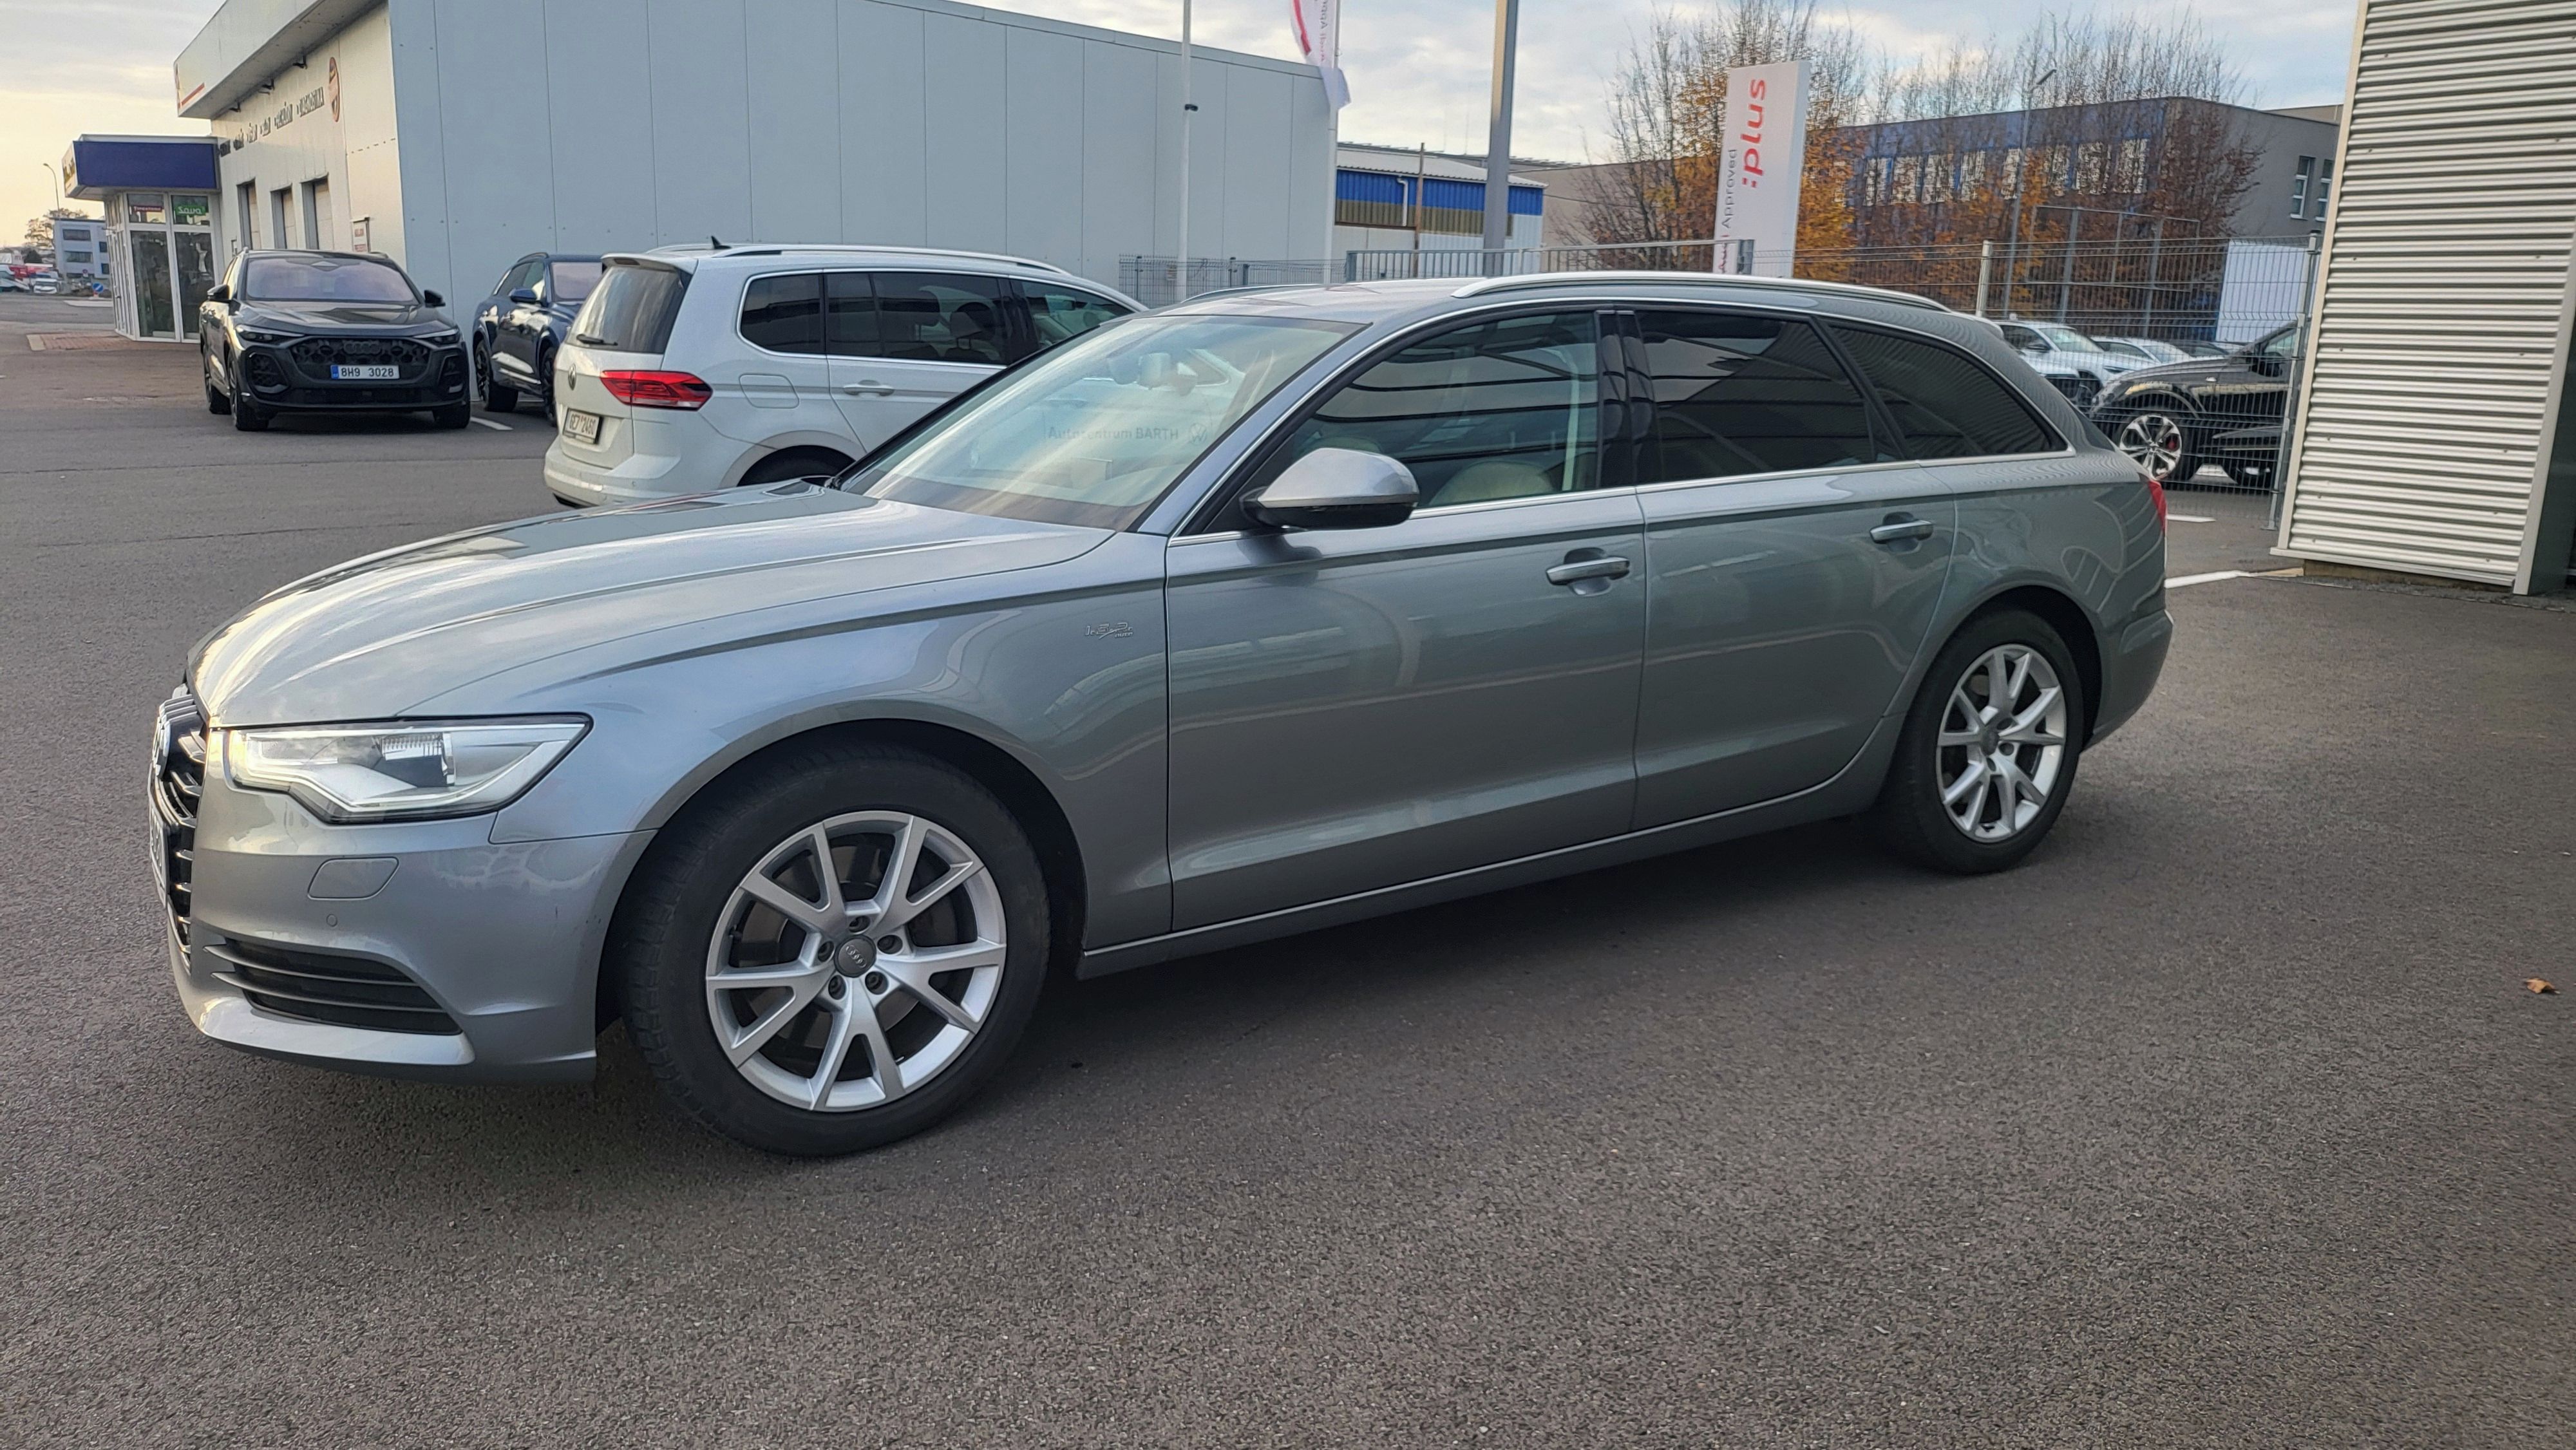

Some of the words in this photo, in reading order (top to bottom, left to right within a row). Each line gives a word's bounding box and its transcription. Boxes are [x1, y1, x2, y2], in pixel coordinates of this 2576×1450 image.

[1740, 79, 1766, 188] :plus
[1721, 149, 1738, 229] Approved
[341, 367, 361, 377] 8H9
[368, 367, 394, 377] 3028
[1135, 426, 1179, 440] BARTH
